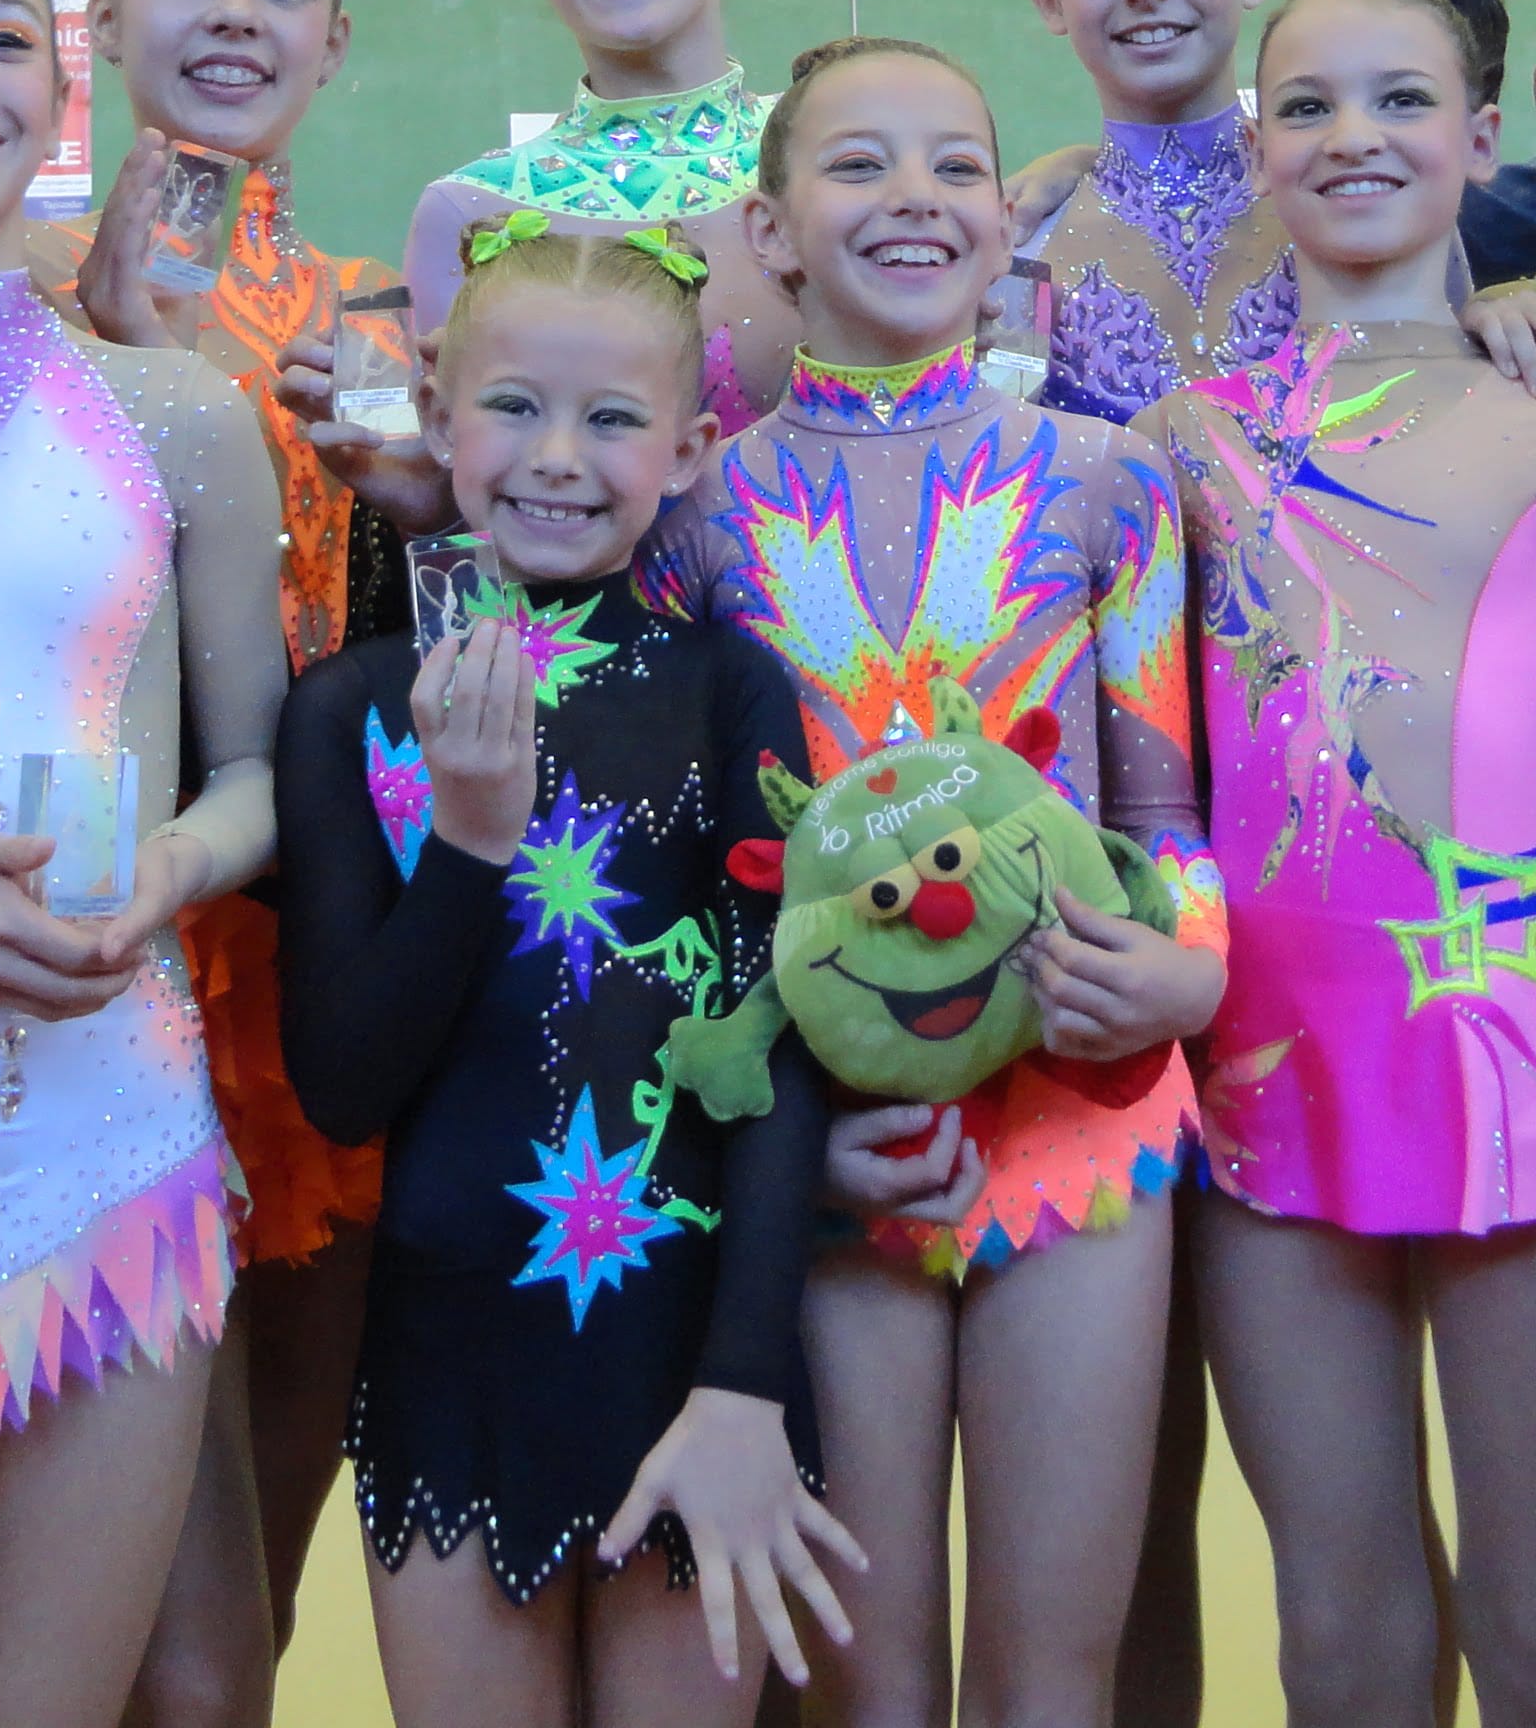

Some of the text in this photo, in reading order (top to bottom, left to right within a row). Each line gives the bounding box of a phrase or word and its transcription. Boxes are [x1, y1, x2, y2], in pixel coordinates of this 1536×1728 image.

[884, 742, 966, 760] contigo
[820, 764, 980, 852] Yo Rítmica
